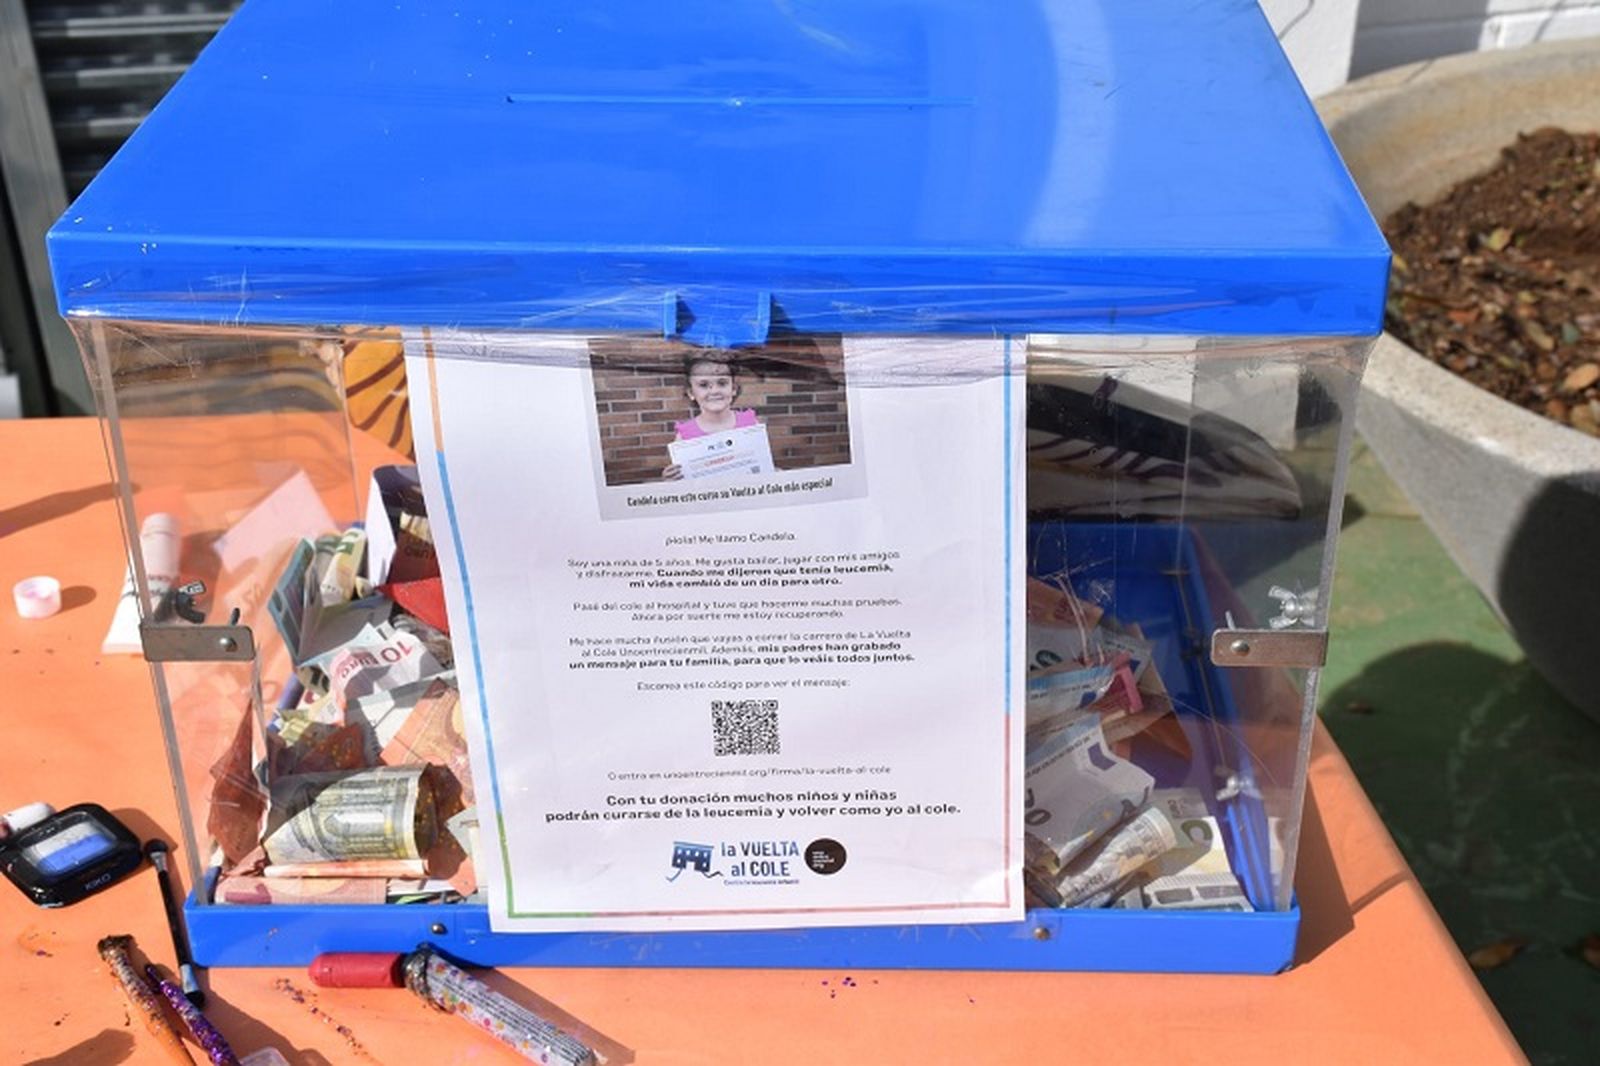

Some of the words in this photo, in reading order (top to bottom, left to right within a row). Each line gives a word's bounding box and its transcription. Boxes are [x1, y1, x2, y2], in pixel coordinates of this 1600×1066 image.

[627, 495, 658, 507] Candela
[697, 492, 719, 501] curso
[720, 491, 730, 499] su
[730, 487, 757, 497] Vuelta
[758, 485, 765, 495] al
[766, 483, 783, 494] Cole
[784, 481, 800, 492] más
[801, 477, 833, 492] especial
[698, 535, 714, 545] Me
[715, 535, 747, 543] llamo
[567, 559, 589, 568] Soy
[655, 559, 663, 567] 5
[695, 557, 711, 566] Me
[713, 557, 744, 568] gusta
[815, 555, 835, 563] con
[837, 554, 857, 562] mis
[657, 569, 703, 577] Cuando
[727, 567, 771, 578] dijeron
[773, 568, 797, 577] que
[629, 580, 645, 588] mi
[647, 579, 674, 588] vida
[676, 578, 721, 588] cambió
[723, 579, 739, 587] de
[759, 577, 779, 587] día
[782, 579, 809, 587] para
[811, 577, 842, 585] otro.
[573, 602, 599, 611] Pasé
[601, 602, 618, 611] del
[620, 602, 643, 610] cole
[645, 601, 655, 610] al
[657, 601, 701, 611] hospital
[739, 601, 758, 610] que
[761, 600, 809, 609] hacerme
[811, 599, 853, 607] muchas
[631, 613, 664, 621] Ahora
[665, 613, 684, 623] por
[687, 611, 721, 621] suerte
[743, 611, 772, 620] estoy
[569, 637, 585, 646] Me
[615, 636, 651, 645] mucha
[690, 635, 710, 645] que
[712, 635, 743, 645] vayas
[754, 633, 788, 642] correr
[789, 632, 800, 641] la
[802, 633, 842, 641] carrera
[844, 631, 858, 640] de
[877, 630, 911, 639] Vuelta
[380, 641, 413, 663] 10
[581, 649, 591, 657] al
[593, 647, 617, 657] Cole
[757, 644, 780, 653] mis
[782, 643, 823, 654] padres
[825, 643, 849, 651] han
[851, 641, 901, 653] grabado
[587, 659, 637, 670] mensaje
[639, 660, 667, 669] para
[669, 659, 683, 667] tu
[733, 657, 761, 666] para
[763, 657, 786, 666] que
[788, 655, 801, 664] lo
[836, 653, 871, 663] todos
[873, 653, 915, 664] juntos.
[637, 681, 681, 691] Escanea
[708, 680, 743, 691] código
[745, 681, 770, 690] para
[772, 680, 789, 688] ver
[791, 678, 801, 688] el
[618, 772, 644, 780] entra
[606, 795, 636, 806] Con
[639, 796, 656, 805] tu
[660, 793, 731, 805] donación
[734, 792, 793, 803] muchos
[797, 791, 839, 801] niños
[855, 789, 897, 801] niñas
[545, 810, 599, 823] podrán
[603, 811, 661, 821] curarse
[665, 809, 683, 819] de
[685, 808, 701, 818] la
[703, 806, 773, 818] leucemia
[789, 805, 836, 816] volver
[839, 807, 881, 815] como
[885, 806, 903, 817] yo
[907, 804, 921, 814] al
[924, 803, 961, 815] cole.
[721, 842, 737, 857] la
[740, 841, 799, 857] VUELTA
[731, 862, 745, 877] al
[750, 861, 790, 877] COLE
